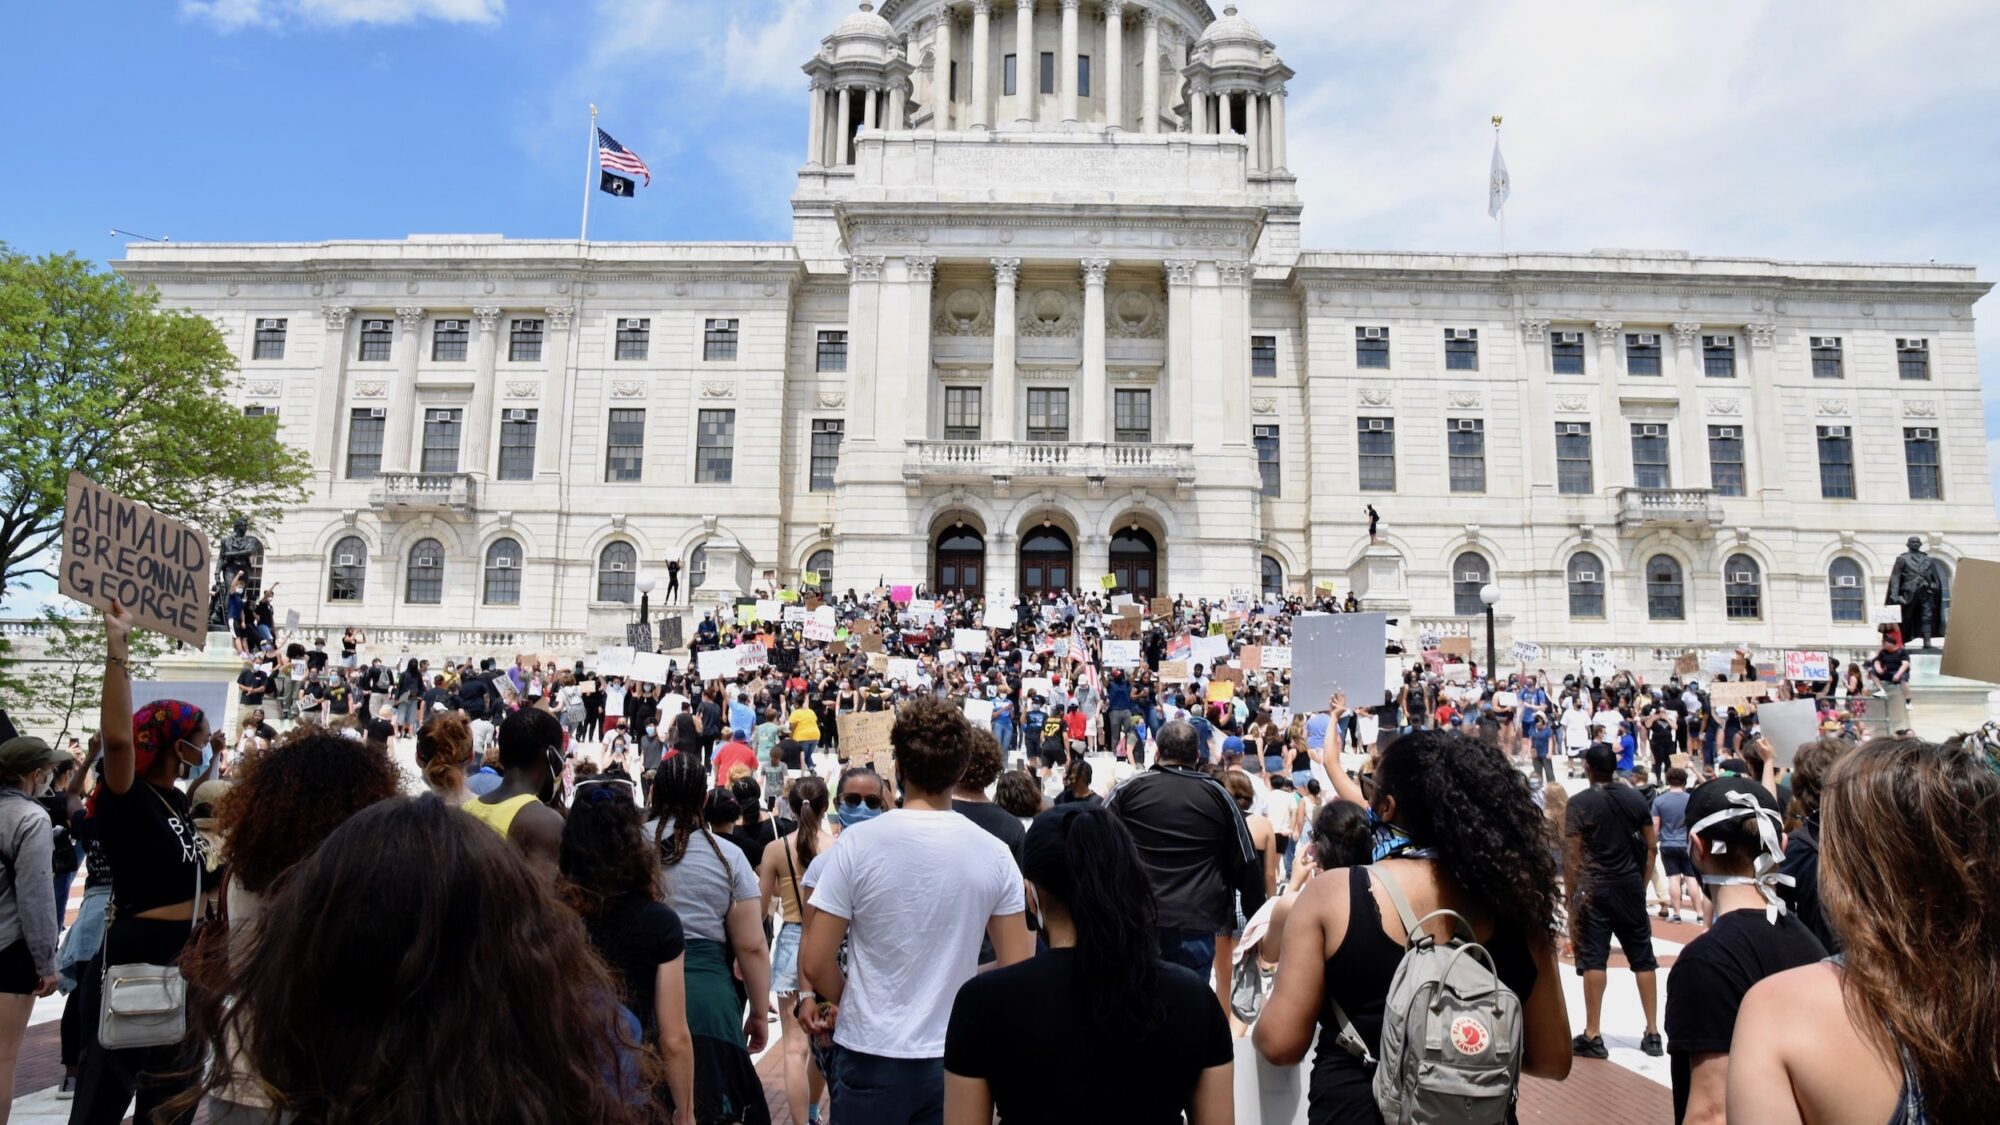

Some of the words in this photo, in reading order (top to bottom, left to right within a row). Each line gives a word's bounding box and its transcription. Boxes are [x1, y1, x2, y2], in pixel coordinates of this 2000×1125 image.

[72, 527, 198, 603] BREONNA
[73, 487, 204, 572] AHMAUD
[68, 561, 197, 632] GEORGE
[1787, 652, 1799, 664] NO
